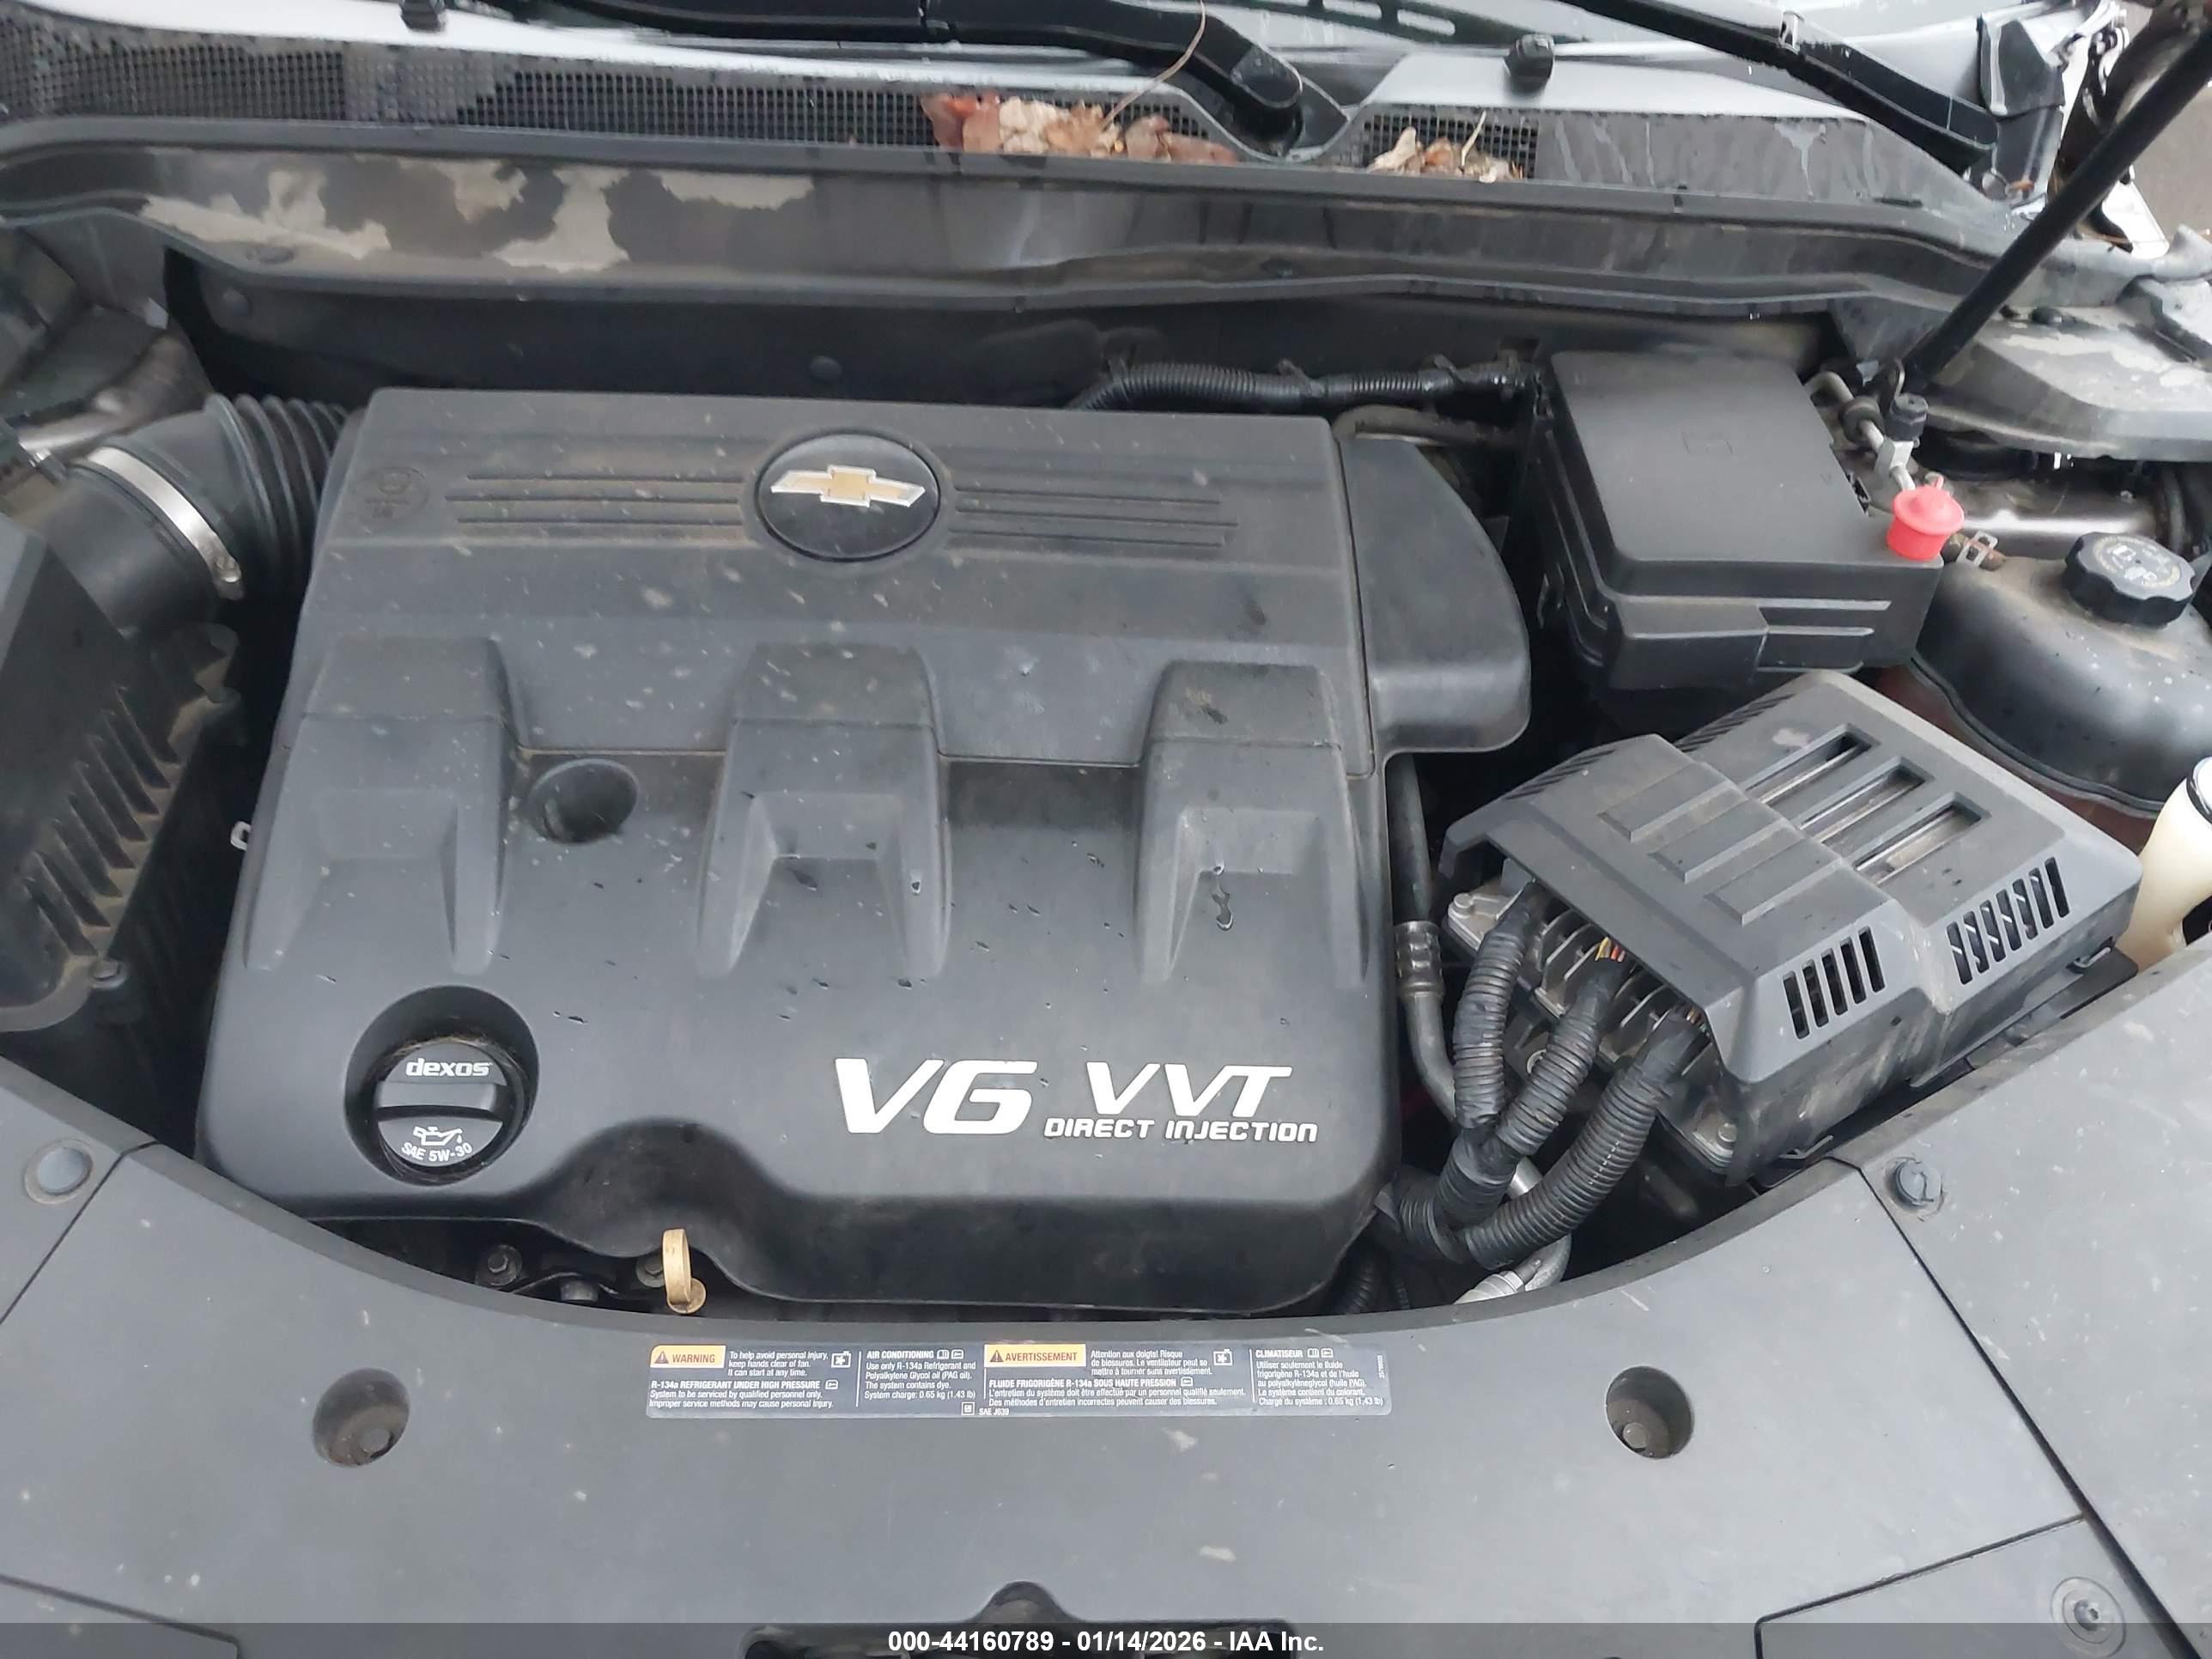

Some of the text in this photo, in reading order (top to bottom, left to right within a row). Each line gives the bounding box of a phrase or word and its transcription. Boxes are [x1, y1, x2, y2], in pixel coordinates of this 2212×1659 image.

[405, 1058, 490, 1077] dexos
[835, 1058, 1293, 1133] V6 VVT
[1043, 1117, 1318, 1142] DIRECT INJECTION
[401, 1142, 471, 1161] SAE 5W-30
[672, 1354, 714, 1363] WARNING
[730, 1352, 738, 1360] To
[739, 1352, 754, 1360] help
[757, 1352, 775, 1360] avoid
[777, 1352, 805, 1360] personal
[1006, 1352, 1077, 1361] AVERTISSEMENT
[1091, 1350, 1121, 1358] Attention
[1122, 1350, 1134, 1358] aux
[1160, 1350, 1182, 1358] Risque
[866, 1362, 975, 1370] Use only R-134a Refrigerant and
[1091, 1358, 1207, 1367] de blessures. Le ventilateur peut se
[910, 1371, 930, 1380] Glycol
[942, 1371, 957, 1380] (PAG
[960, 1371, 972, 1380] oil).
[989, 1379, 1015, 1388] FLUIDE
[1017, 1378, 1064, 1388] FRIGORIGÈNE
[865, 1391, 891, 1400] System
[893, 1391, 917, 1400] charge:
[920, 1391, 934, 1400] 0.65
[937, 1391, 945, 1400] kg
[947, 1391, 965, 1400] (1.43
[649, 1400, 833, 1408] Improper service methods may cause personal injury.
[989, 1398, 1001, 1407] Des
[1004, 1398, 1037, 1407] méthodes
[1039, 1398, 1075, 1407] d'entretien
[1077, 1398, 1114, 1407] incorrectes
